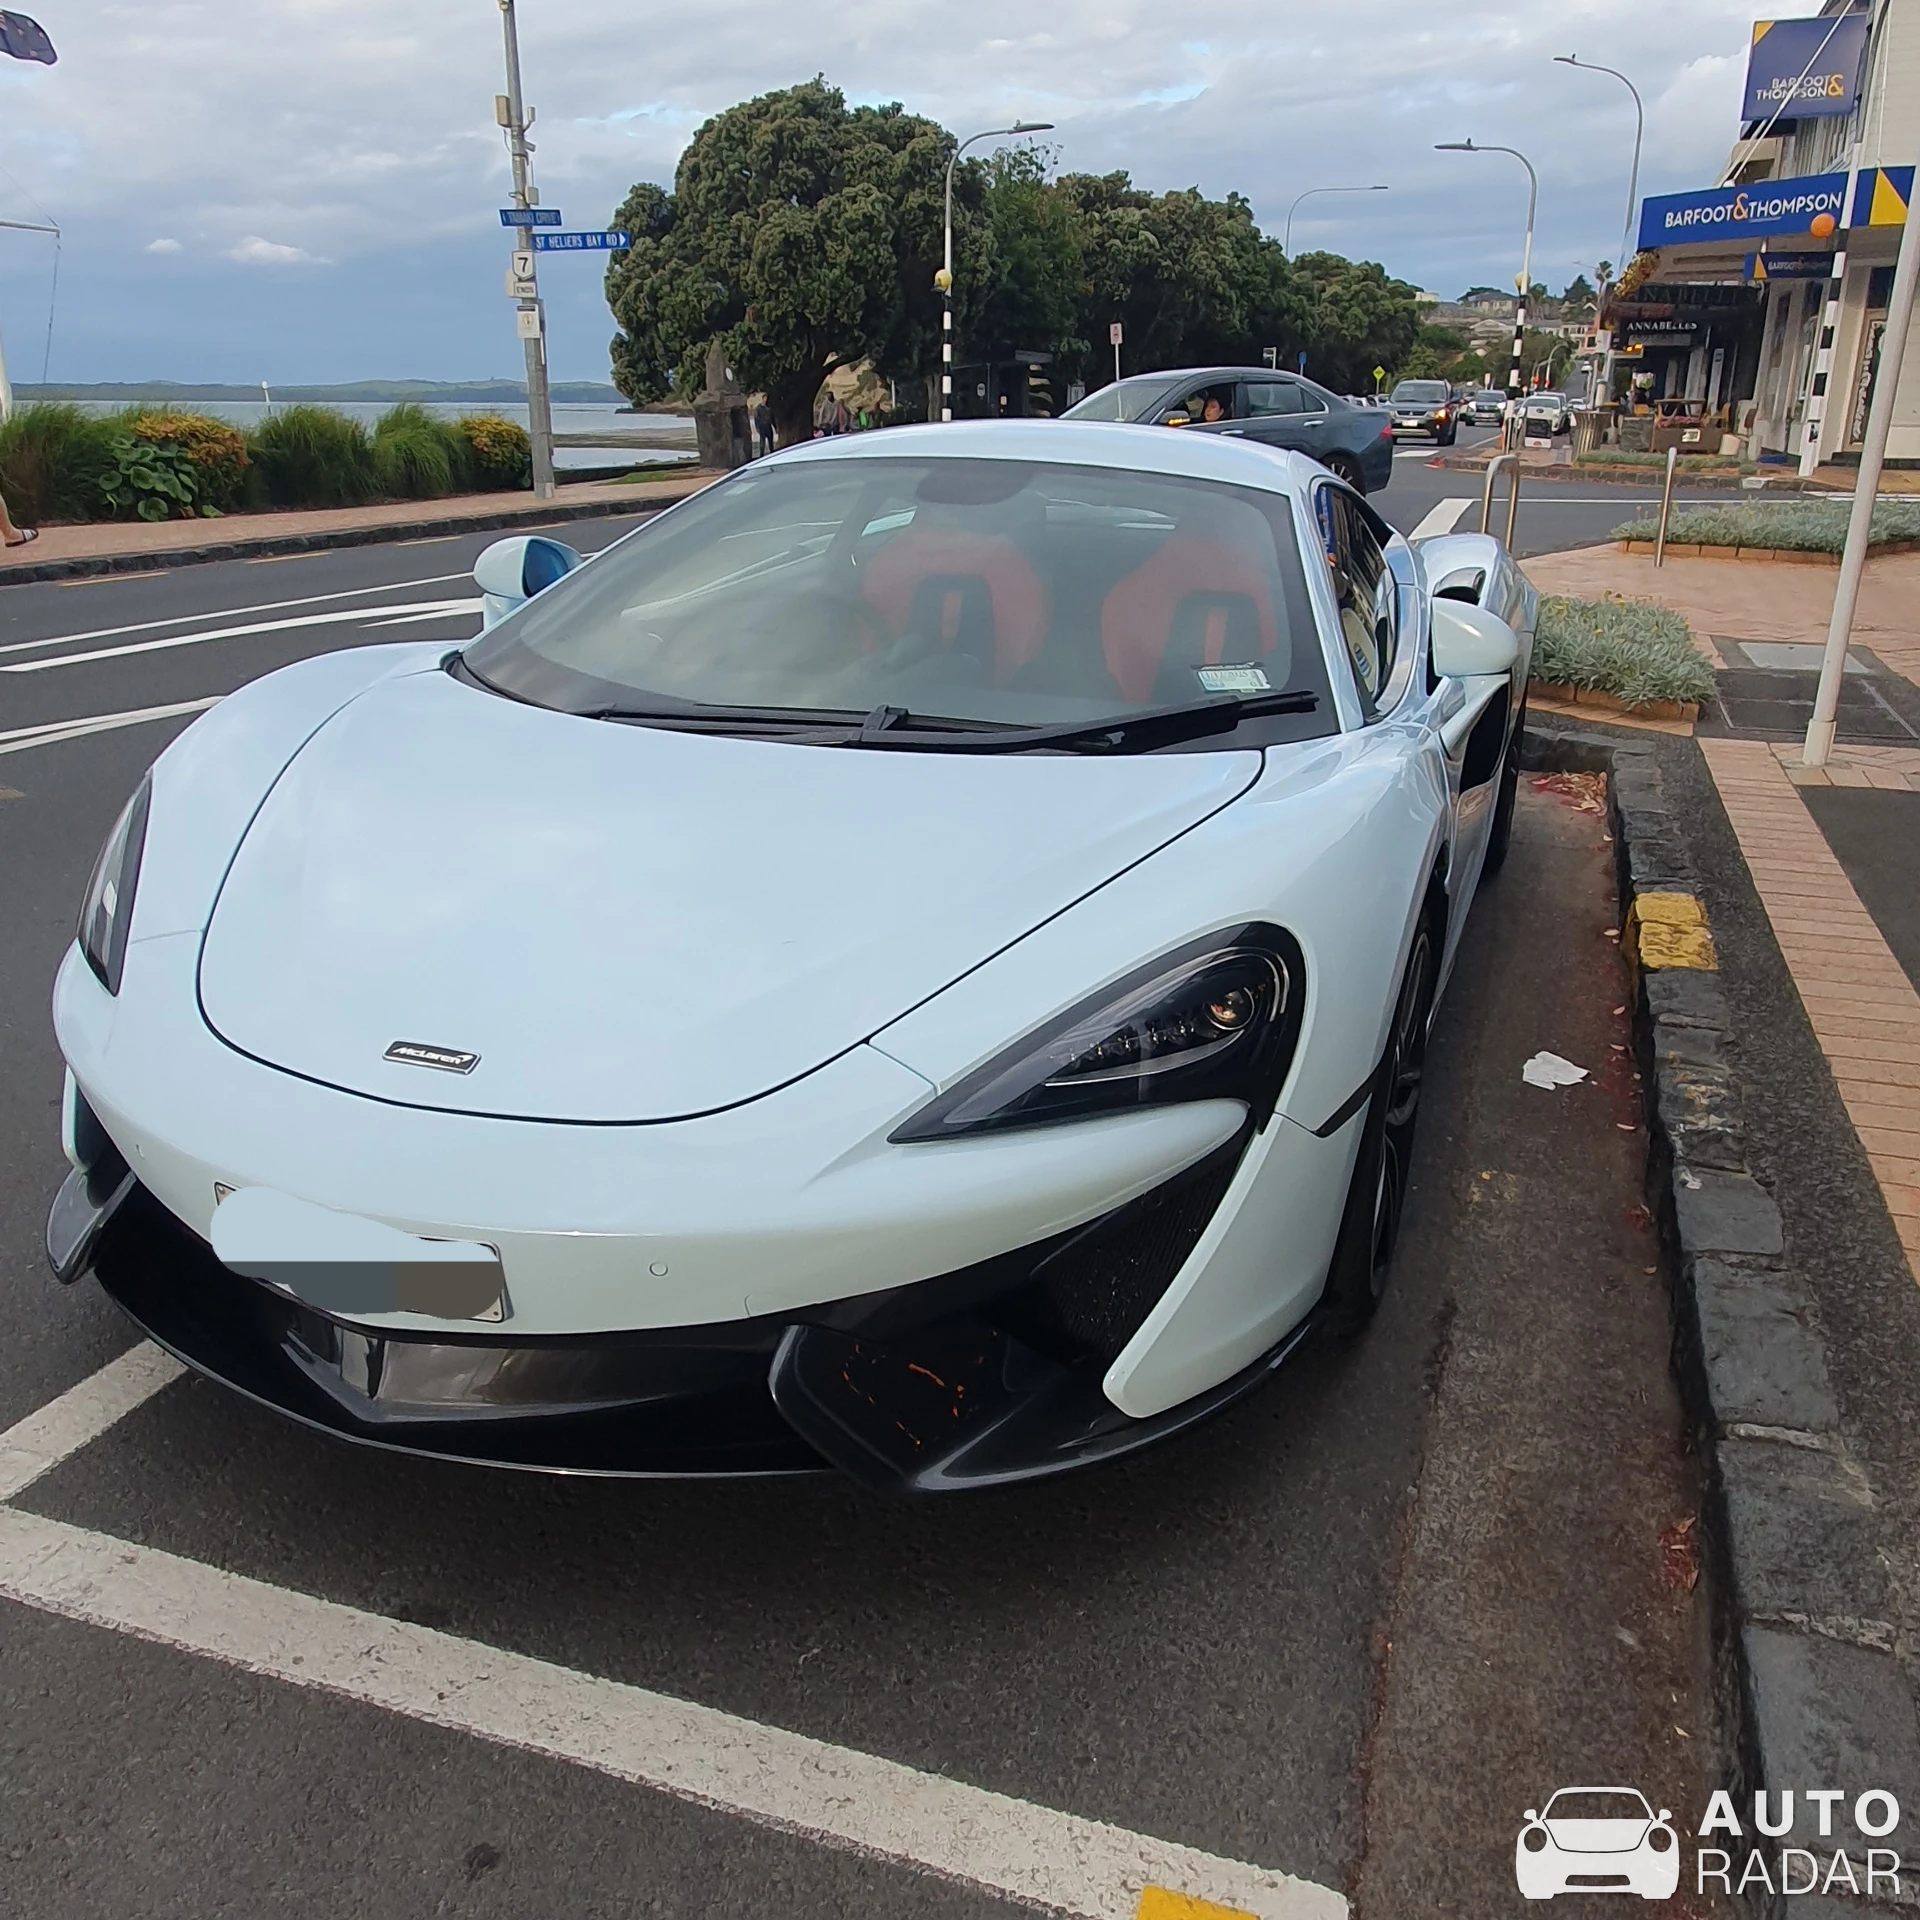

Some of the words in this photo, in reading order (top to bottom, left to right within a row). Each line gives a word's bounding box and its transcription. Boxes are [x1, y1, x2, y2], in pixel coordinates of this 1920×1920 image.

[1771, 75, 1831, 90] BAROOT
[536, 237, 545, 248] ST
[548, 235, 583, 249] HELIERS
[586, 235, 602, 247] BAY
[606, 233, 618, 246] RD
[517, 257, 528, 273] 7
[392, 1047, 463, 1065] McLaren
